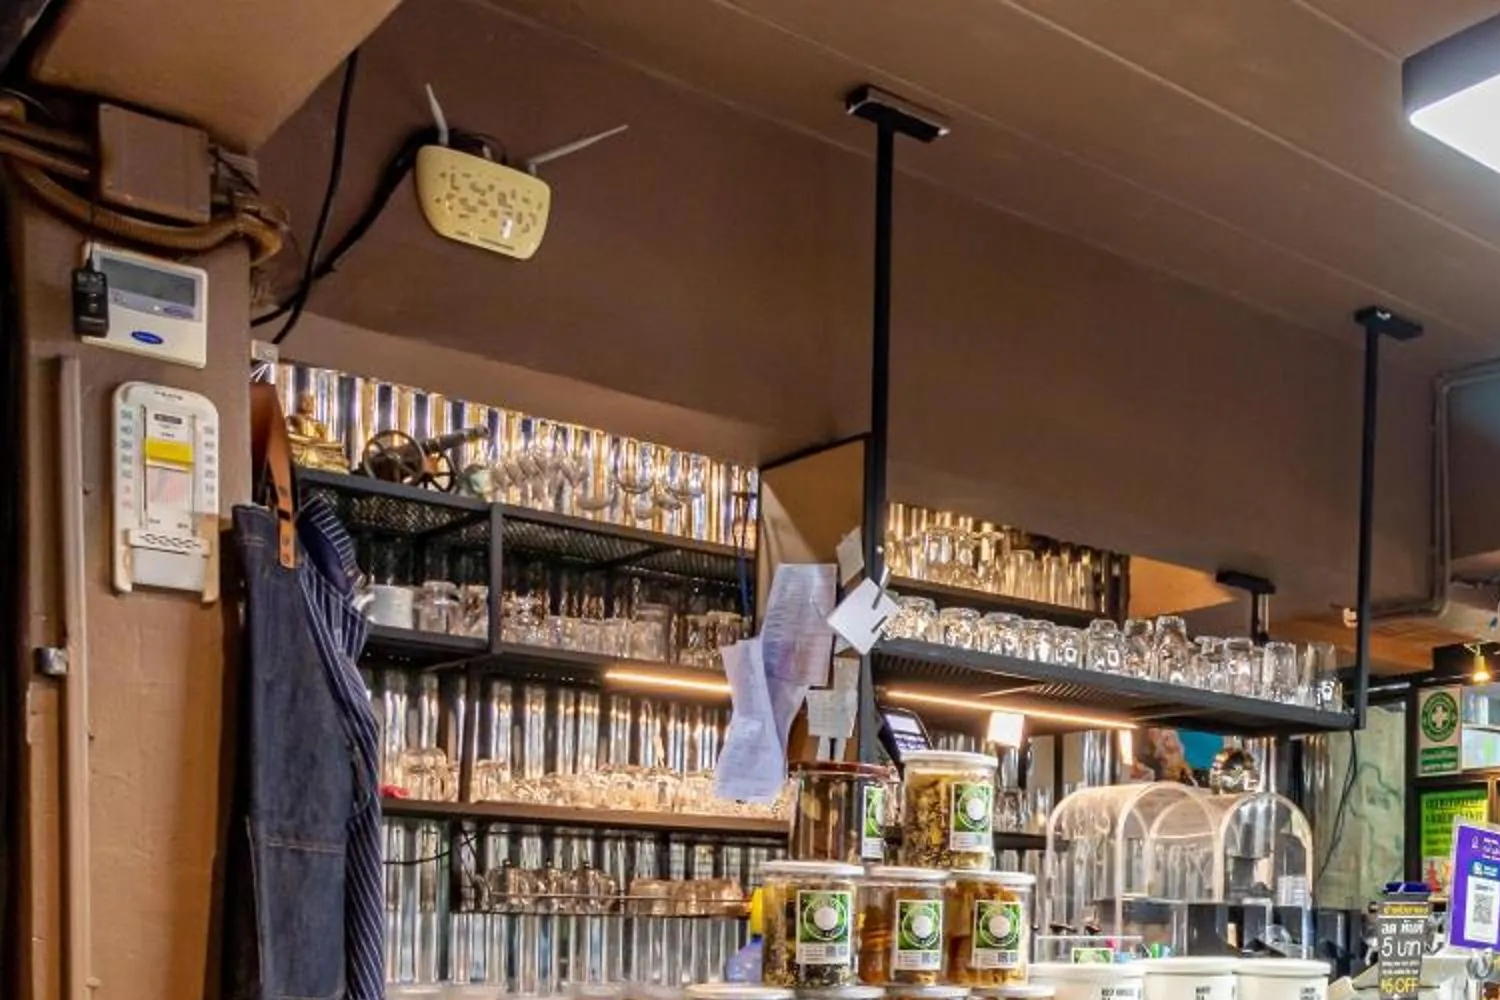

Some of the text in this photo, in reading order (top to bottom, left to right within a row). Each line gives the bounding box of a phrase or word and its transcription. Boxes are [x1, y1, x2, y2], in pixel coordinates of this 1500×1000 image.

[1381, 937, 1421, 957] 5 บาท
[1395, 977, 1416, 993] OFF
